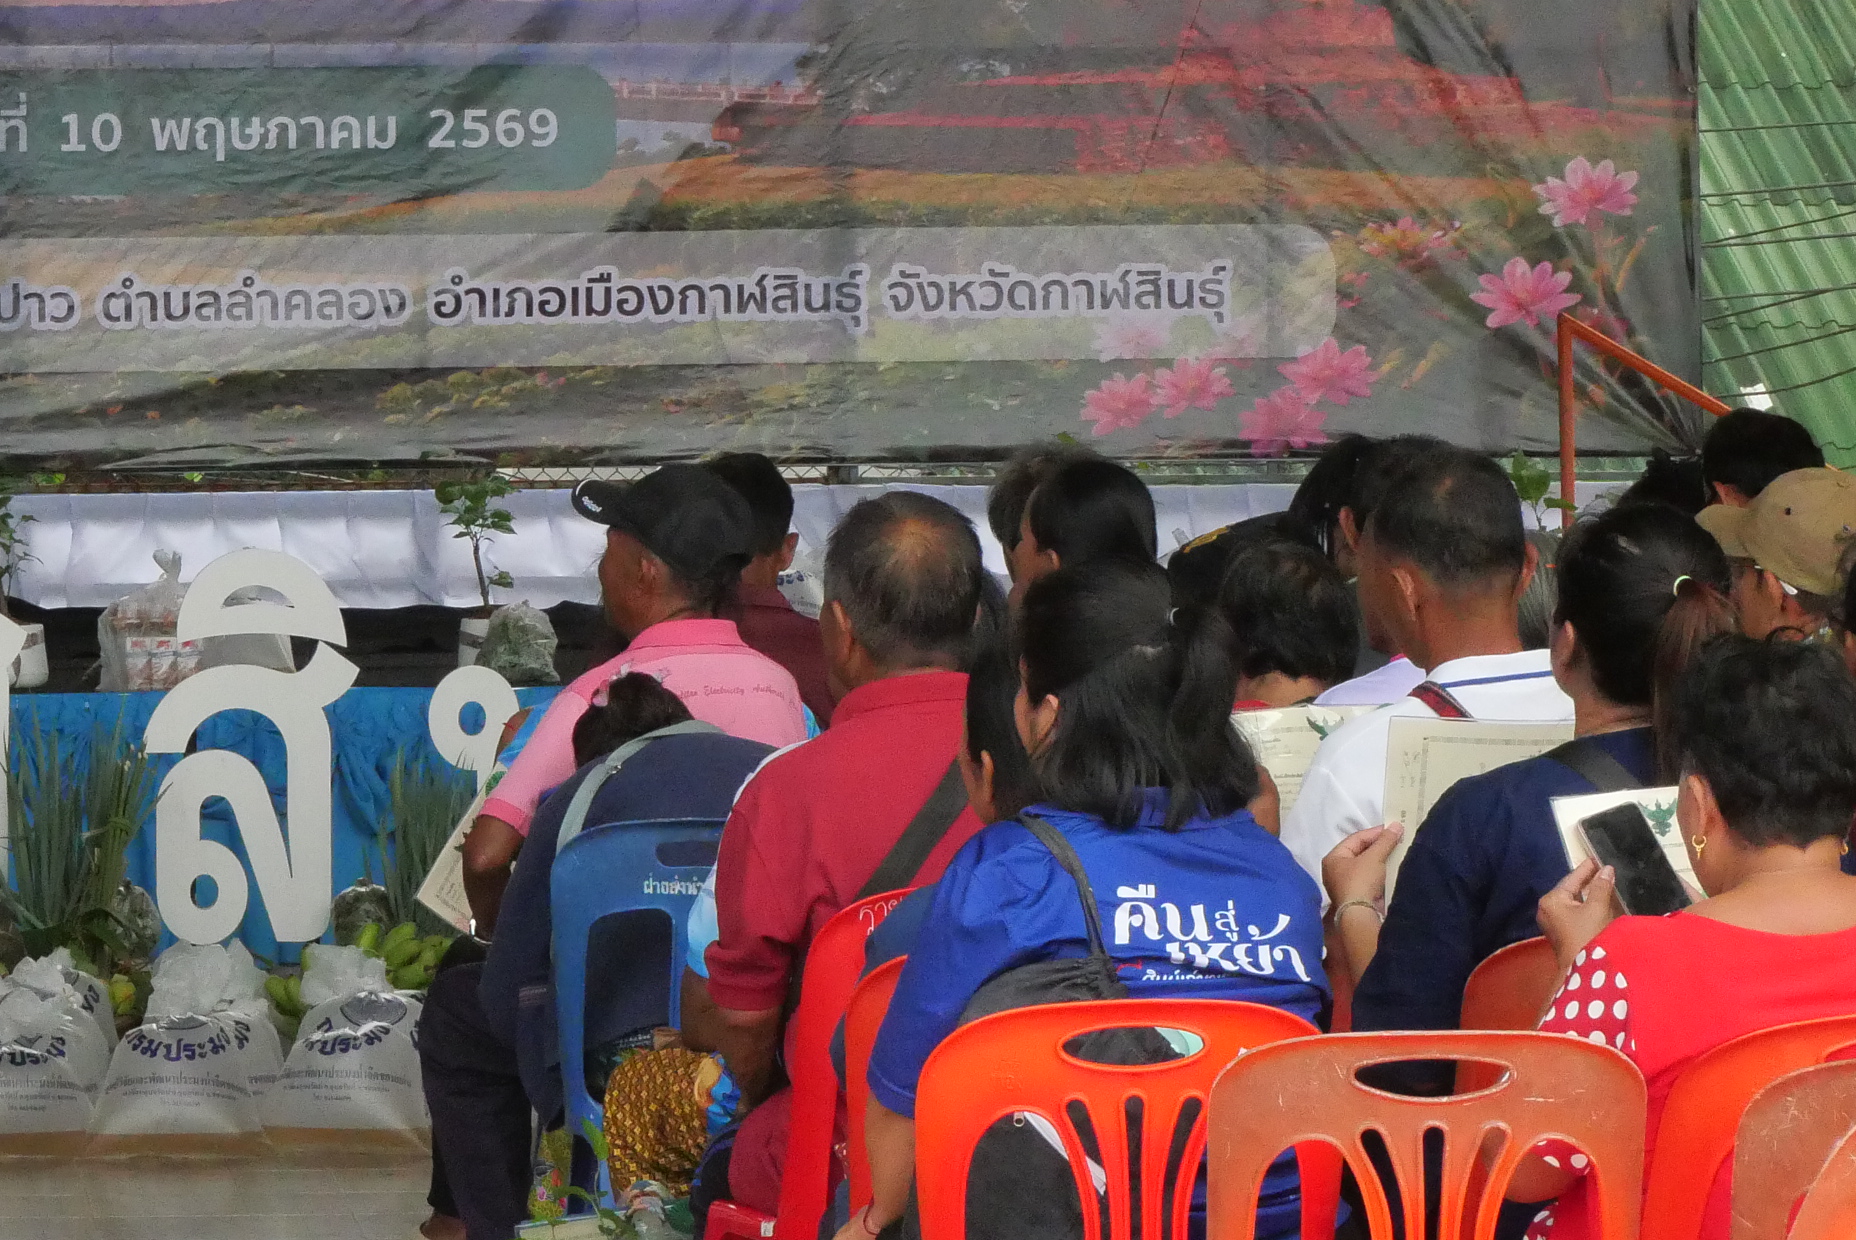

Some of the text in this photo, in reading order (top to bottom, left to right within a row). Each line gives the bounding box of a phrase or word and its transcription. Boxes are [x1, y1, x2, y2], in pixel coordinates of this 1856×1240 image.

[60, 112, 123, 152] 10
[150, 110, 399, 162] พฤษภาคม
[427, 107, 560, 149] 2569
[101, 275, 407, 323] ตำบลลำคลอง
[432, 269, 863, 325] อำเภอเมืองกาฬสินธุ์
[888, 264, 1227, 324] จังหวัดกาฬสินธุ์
